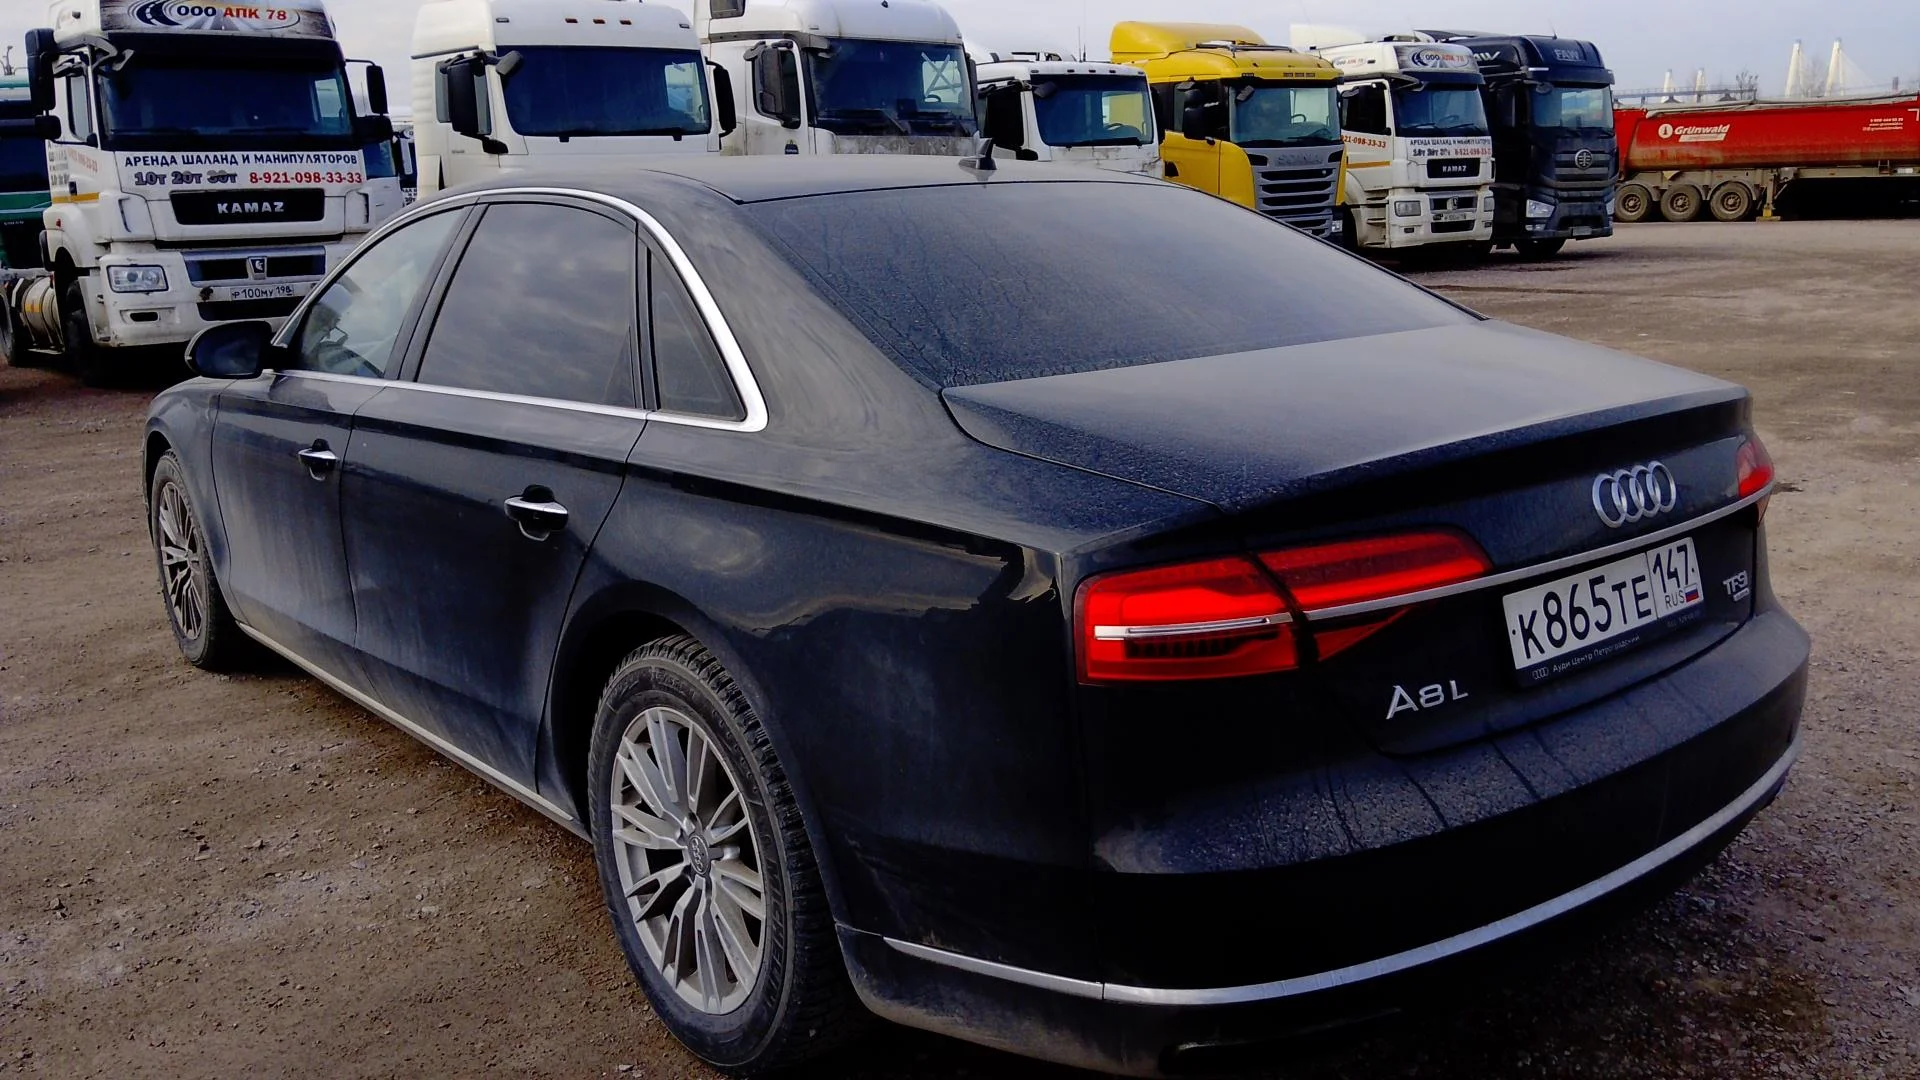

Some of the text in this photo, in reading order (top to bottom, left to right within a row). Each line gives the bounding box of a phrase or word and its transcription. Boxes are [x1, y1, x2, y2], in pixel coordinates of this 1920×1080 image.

[177, 5, 287, 21] ООО АПК 78
[1674, 124, 1731, 135] Grünwald
[125, 153, 358, 167] АРЕНДА ШАЛАНД И МАНИПУЛЯТОРОВ
[1442, 165, 1467, 173] KAMAZ
[249, 171, 363, 184] 8-921-098-33-33
[217, 201, 285, 214] KAMAZ
[1652, 543, 1690, 595] 147
[1665, 592, 1685, 610] RUS
[1552, 661, 1571, 673] Ауди
